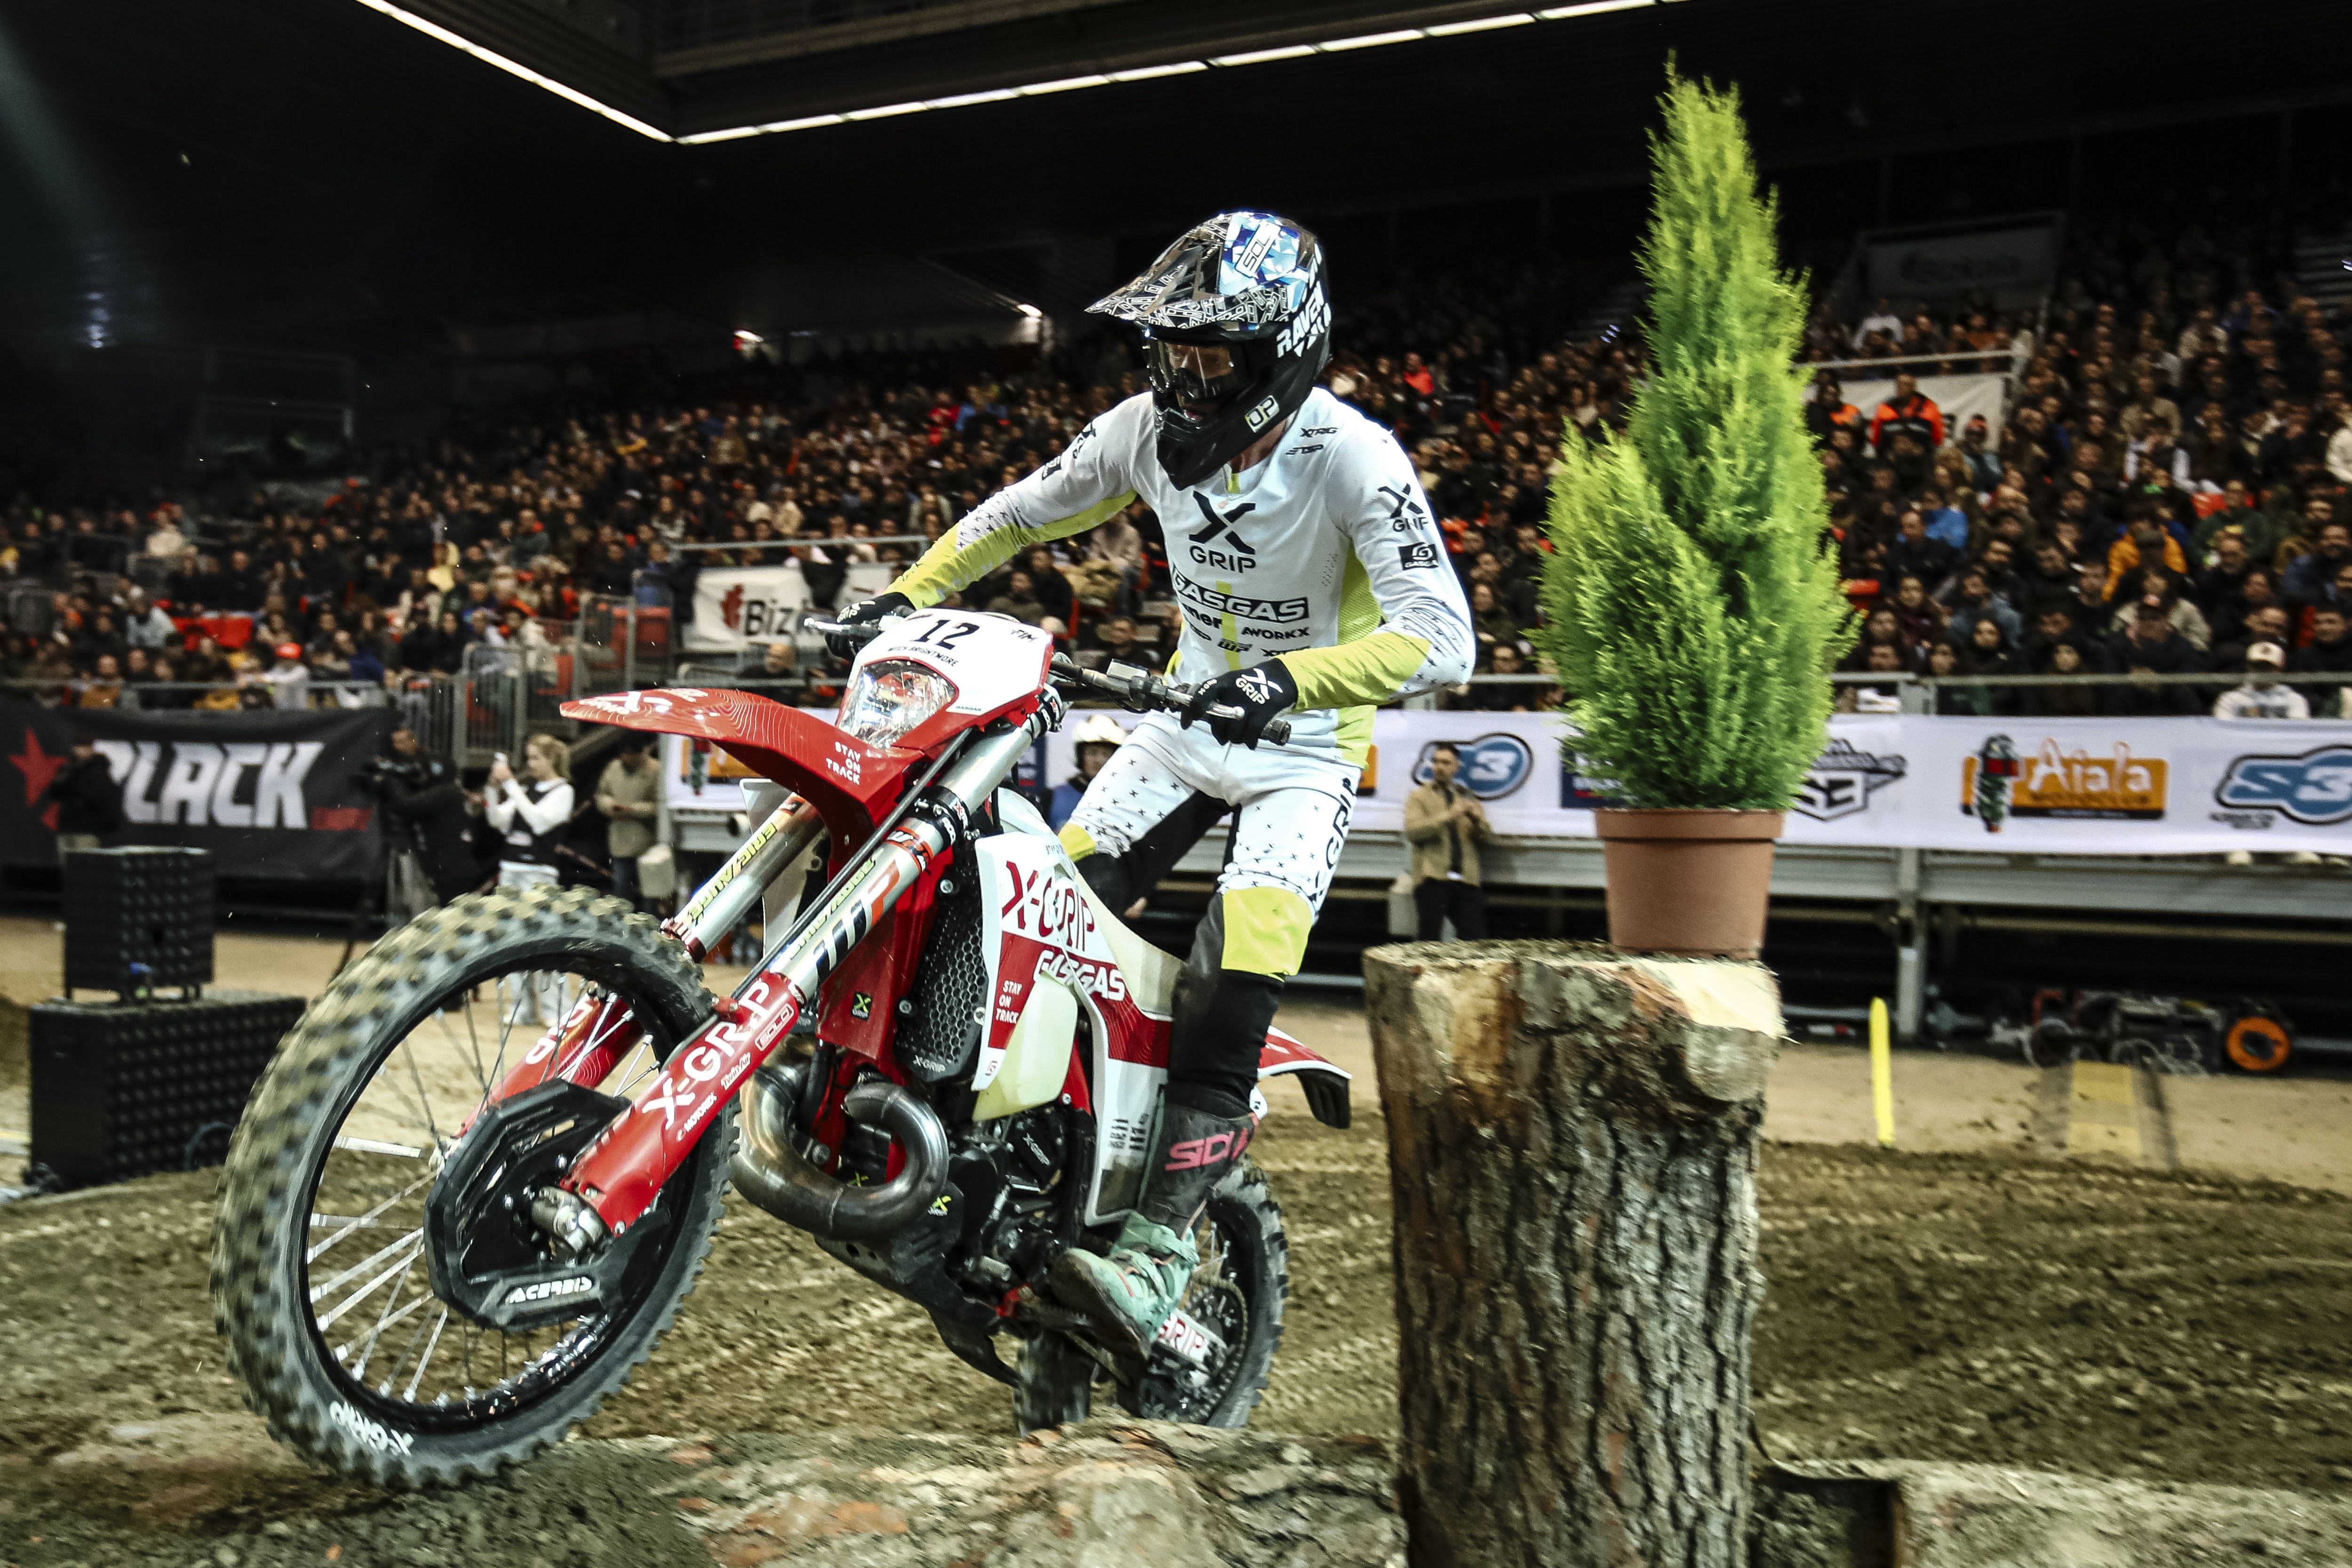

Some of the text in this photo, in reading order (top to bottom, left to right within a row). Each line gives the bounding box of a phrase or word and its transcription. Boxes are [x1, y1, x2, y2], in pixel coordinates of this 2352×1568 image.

[1189, 546, 1256, 574] GRIP
[1173, 569, 1307, 623] GASGAS
[745, 598, 803, 636] Biz
[910, 619, 980, 650] 12
[1235, 677, 1265, 705] GRIP
[835, 741, 861, 761] STAY
[826, 757, 860, 785] TRACK
[846, 758, 861, 773] ON
[1002, 860, 1095, 952] X-GRIP
[1002, 980, 1023, 995] STAY
[1033, 950, 1126, 1002] GASGAS
[999, 995, 1012, 1008] ON
[995, 1008, 1020, 1024] TRACK
[642, 980, 772, 1130] X-GRP
[505, 1276, 592, 1305] ACERBIS
